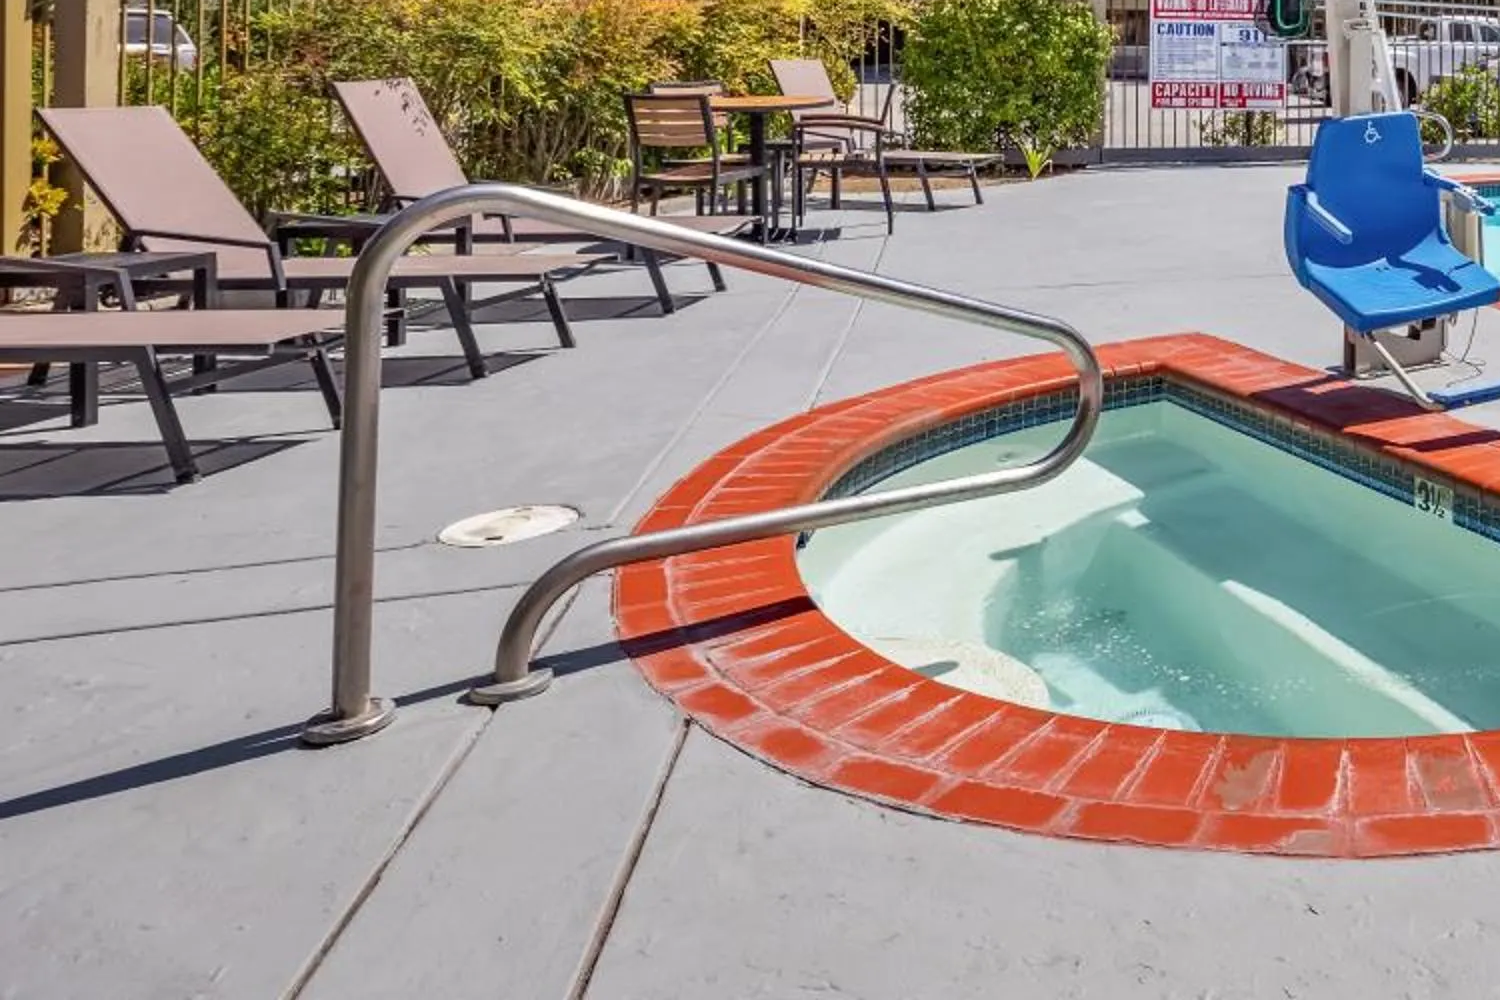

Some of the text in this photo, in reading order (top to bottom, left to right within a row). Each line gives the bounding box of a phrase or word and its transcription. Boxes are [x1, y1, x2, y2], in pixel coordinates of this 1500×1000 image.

[1157, 23, 1215, 37] CAUTION
[1239, 29, 1268, 43] 911
[1155, 83, 1216, 97] CAPACITY
[1224, 83, 1280, 99] NO DIVING
